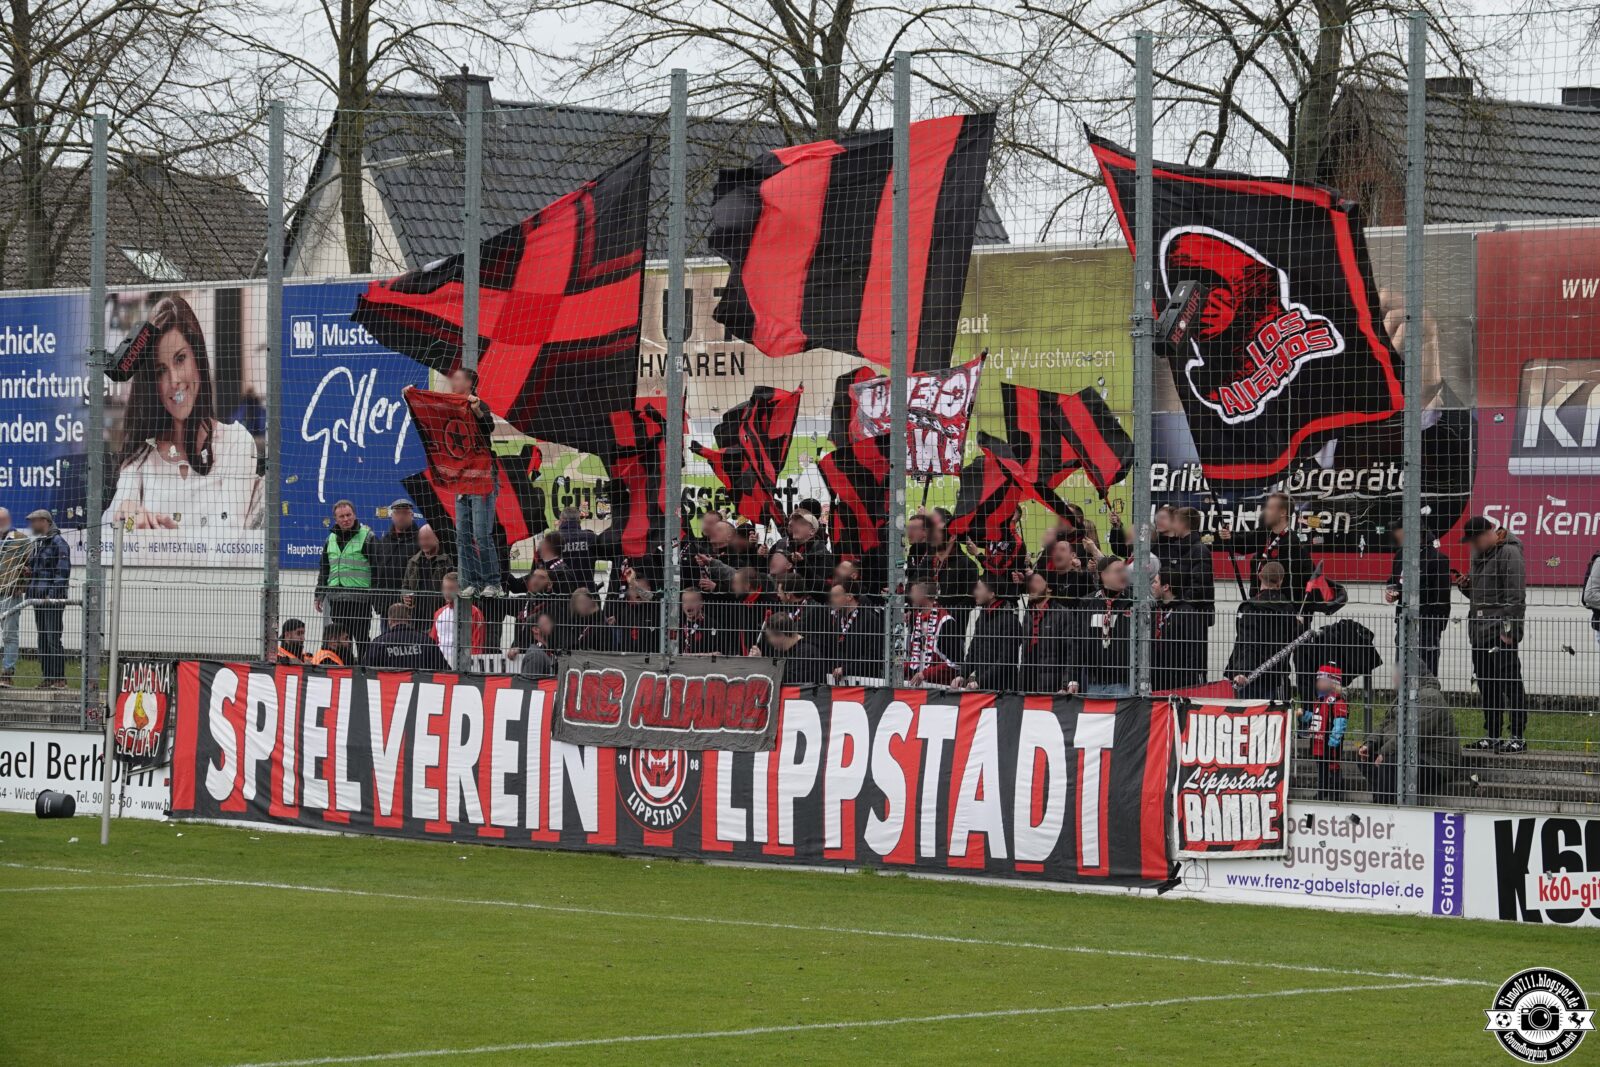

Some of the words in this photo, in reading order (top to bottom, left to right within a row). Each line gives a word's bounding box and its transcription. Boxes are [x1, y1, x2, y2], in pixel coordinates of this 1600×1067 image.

[1171, 288, 1200, 344] BEKHOFF
[322, 324, 378, 346] Muste
[55, 413, 84, 443] Sie
[20, 459, 61, 488] uns!
[1483, 505, 1527, 535] Sie
[148, 541, 207, 555] HEIMTEXTILIEN
[215, 543, 264, 555] ACCESSOIRE
[287, 543, 323, 559] Hauptstra
[386, 644, 422, 657] POLIZEI
[121, 662, 170, 694] BANANA
[116, 728, 161, 758] SQUAD
[1182, 713, 1285, 765] JUGEND
[0, 741, 35, 779] ael
[205, 667, 599, 832] SPIELVEREIN
[715, 699, 1117, 868] LIPPSTADT
[618, 754, 627, 766] 19
[690, 758, 699, 771] 08
[1183, 767, 1278, 795] Lippstadt
[76, 790, 90, 804] Tel.
[627, 791, 688, 826] LIPPSTADT
[1184, 793, 1279, 842] BANDE
[1441, 813, 1455, 915] Gütersloh
[1226, 873, 1424, 899] www.frenz-gabelstapler.de
